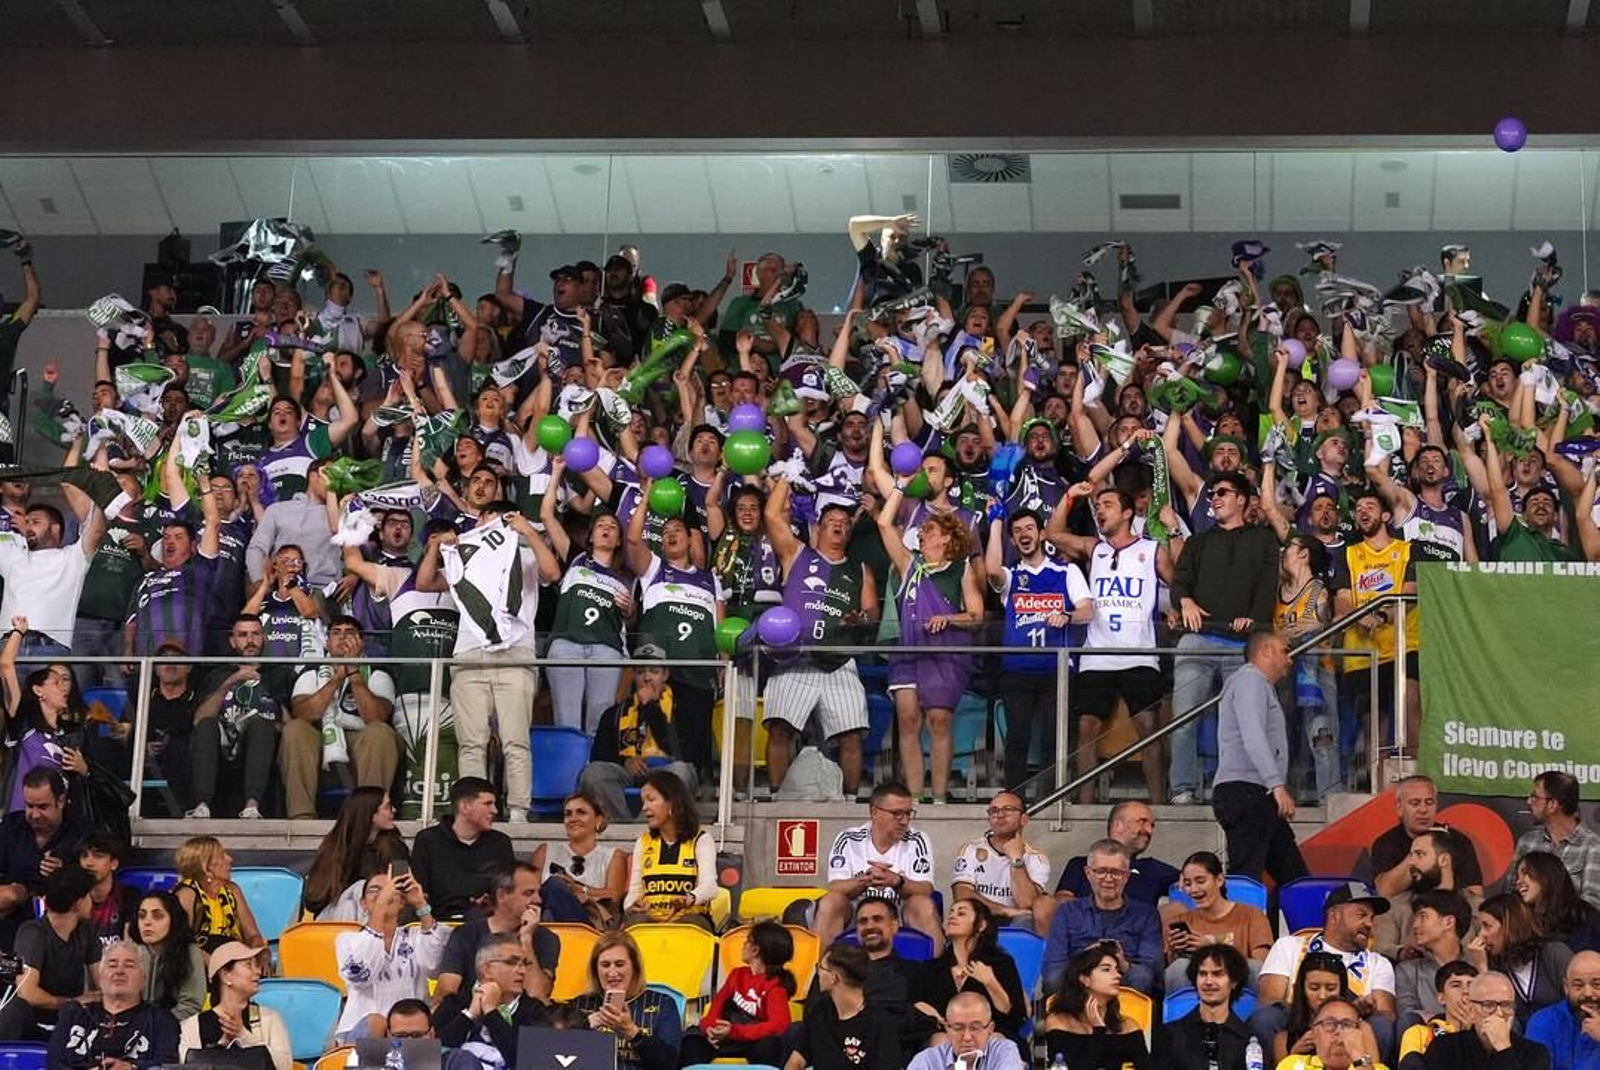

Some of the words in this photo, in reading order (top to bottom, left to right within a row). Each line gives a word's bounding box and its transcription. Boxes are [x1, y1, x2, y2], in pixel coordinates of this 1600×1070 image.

[481, 529, 505, 551] 10
[1094, 575, 1146, 598] TAU
[576, 588, 613, 609] málaga
[804, 600, 843, 617] málaga
[1014, 596, 1063, 609] Adecco
[584, 606, 600, 626] 9
[668, 604, 706, 621] málaga
[1108, 614, 1123, 632] 5
[677, 621, 693, 642] 9
[812, 619, 826, 640] 6
[1026, 627, 1047, 648] 11
[1443, 720, 1538, 750] Siempre
[1541, 728, 1566, 751] te
[1442, 752, 1499, 780] llevo
[778, 861, 816, 872] EXTINTOR
